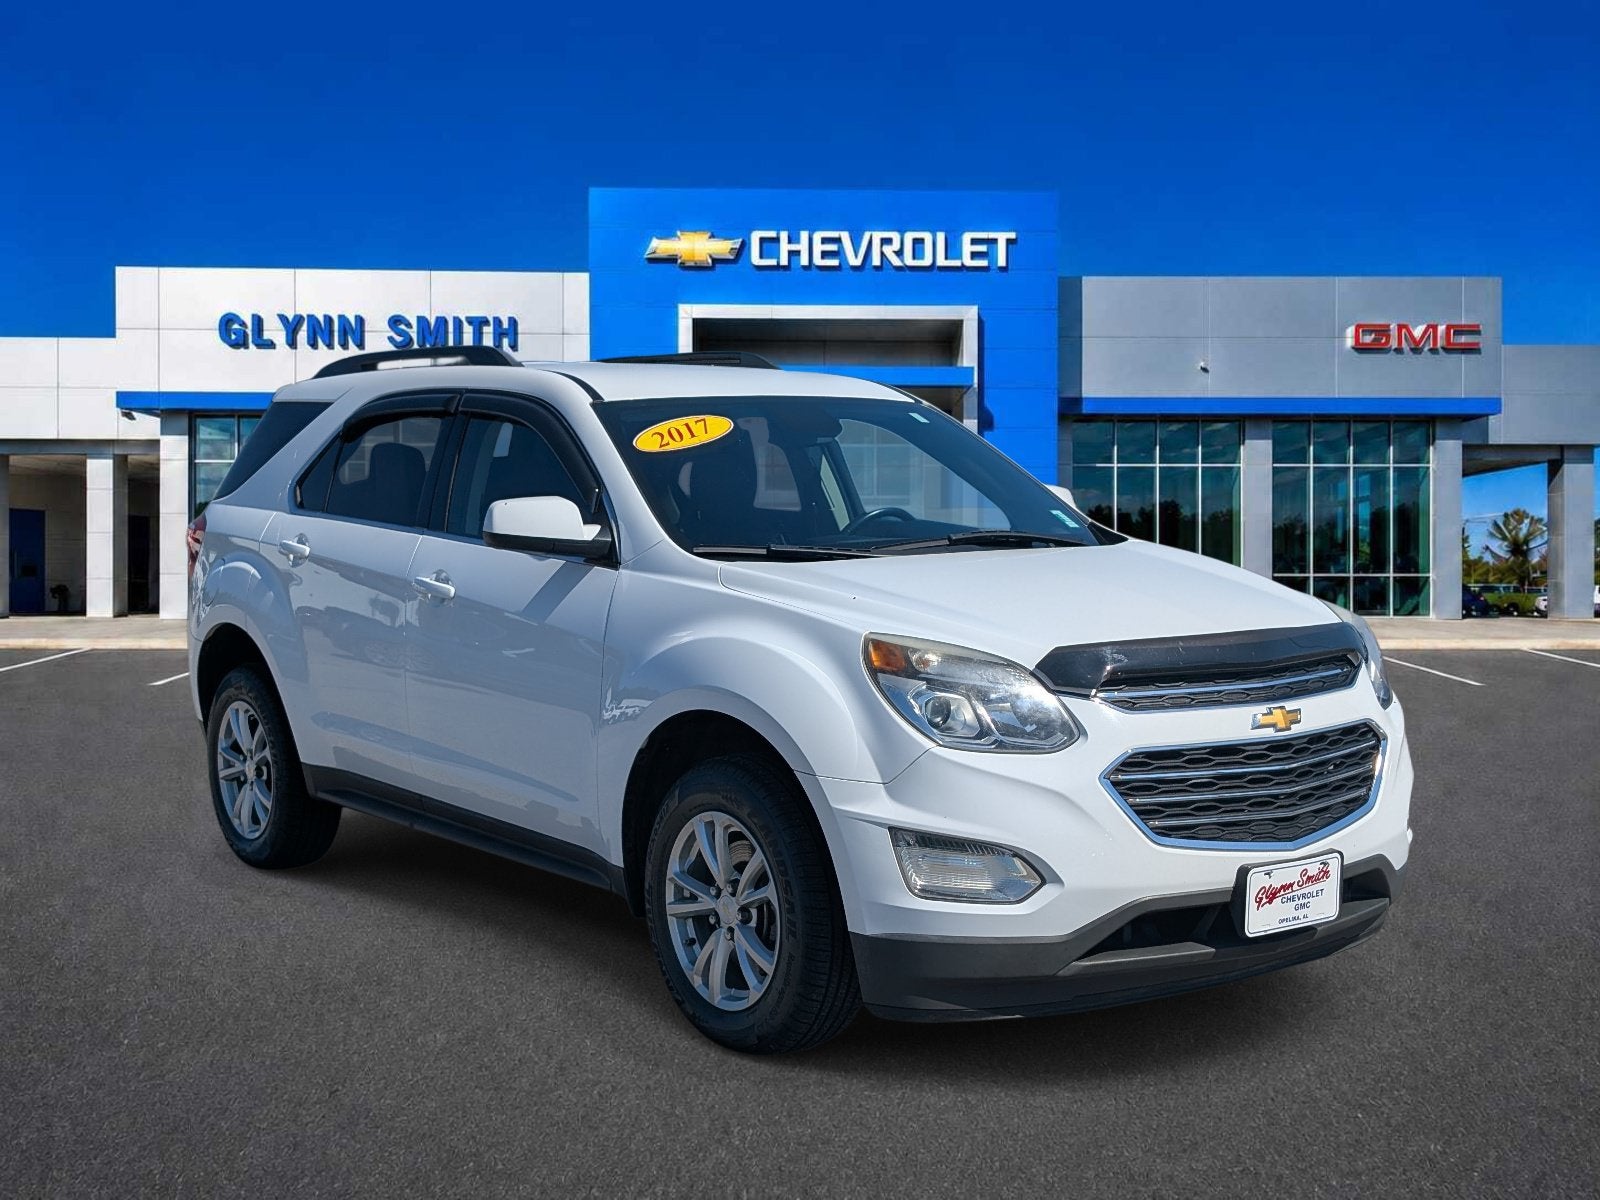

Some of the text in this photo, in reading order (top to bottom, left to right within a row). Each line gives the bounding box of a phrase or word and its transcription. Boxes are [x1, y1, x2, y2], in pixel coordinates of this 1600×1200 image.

[750, 230, 1017, 269] CHEVROLET
[218, 312, 519, 351] GLYNN SMITH
[1349, 323, 1482, 353] GMC
[651, 417, 709, 449] 2017
[1254, 864, 1331, 911] Glynn Smith
[1280, 888, 1325, 904] CHEVROLET
[1278, 914, 1302, 925] OPELIKA,
[1294, 901, 1311, 911] GMC
